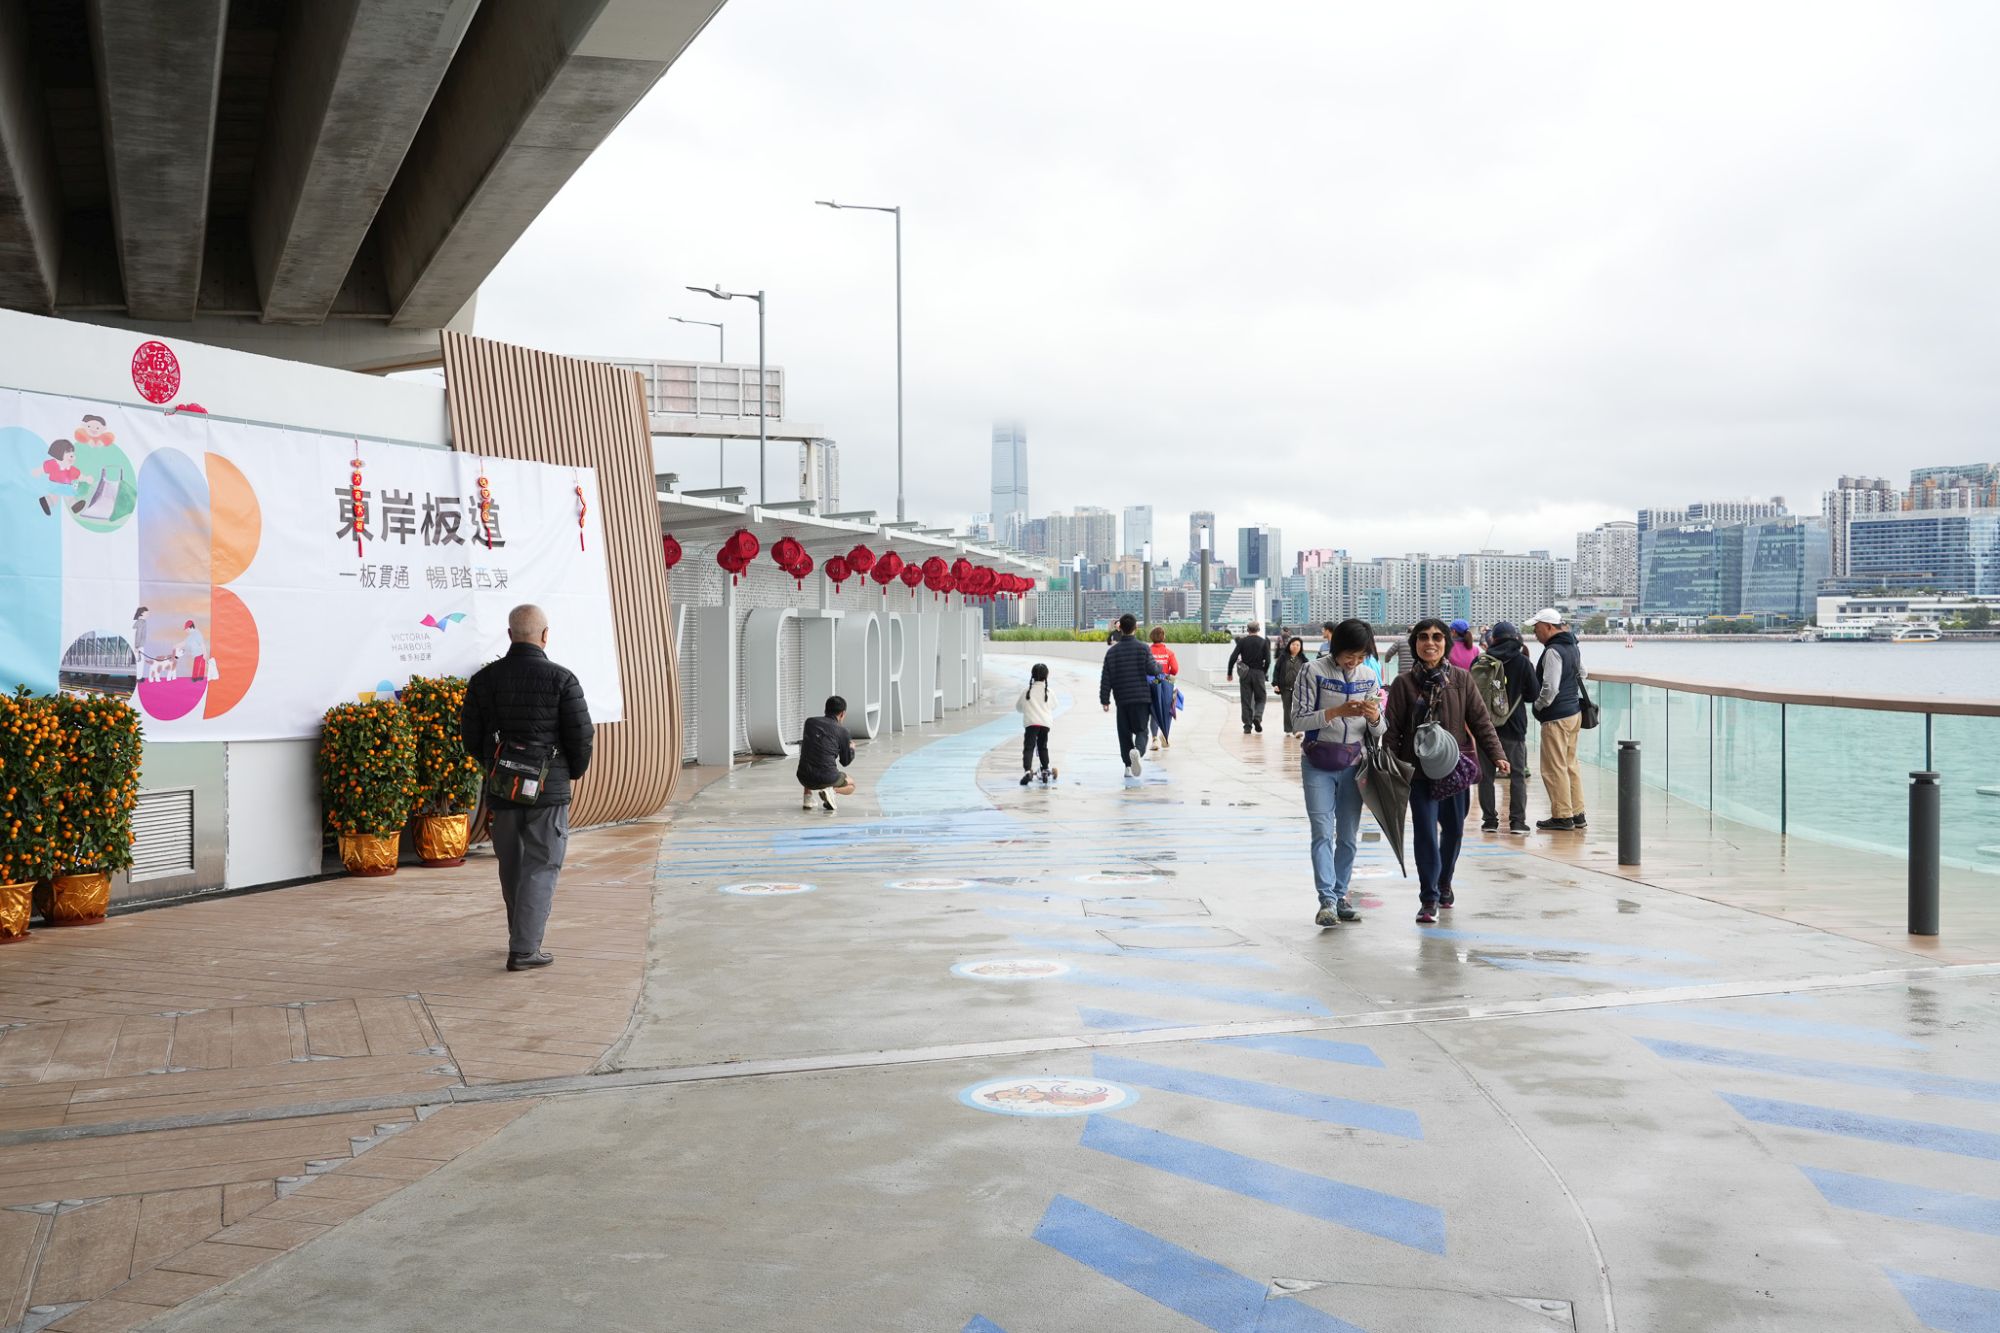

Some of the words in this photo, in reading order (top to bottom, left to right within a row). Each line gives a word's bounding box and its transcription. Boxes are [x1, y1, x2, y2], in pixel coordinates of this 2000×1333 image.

[334, 484, 506, 548] 東岸板道
[339, 564, 410, 590] 一板貫通
[426, 565, 510, 590] 暢踏西東
[391, 632, 430, 642] VICTORIA
[391, 642, 432, 652] HARBOUR
[671, 603, 945, 770] ICTORIA
